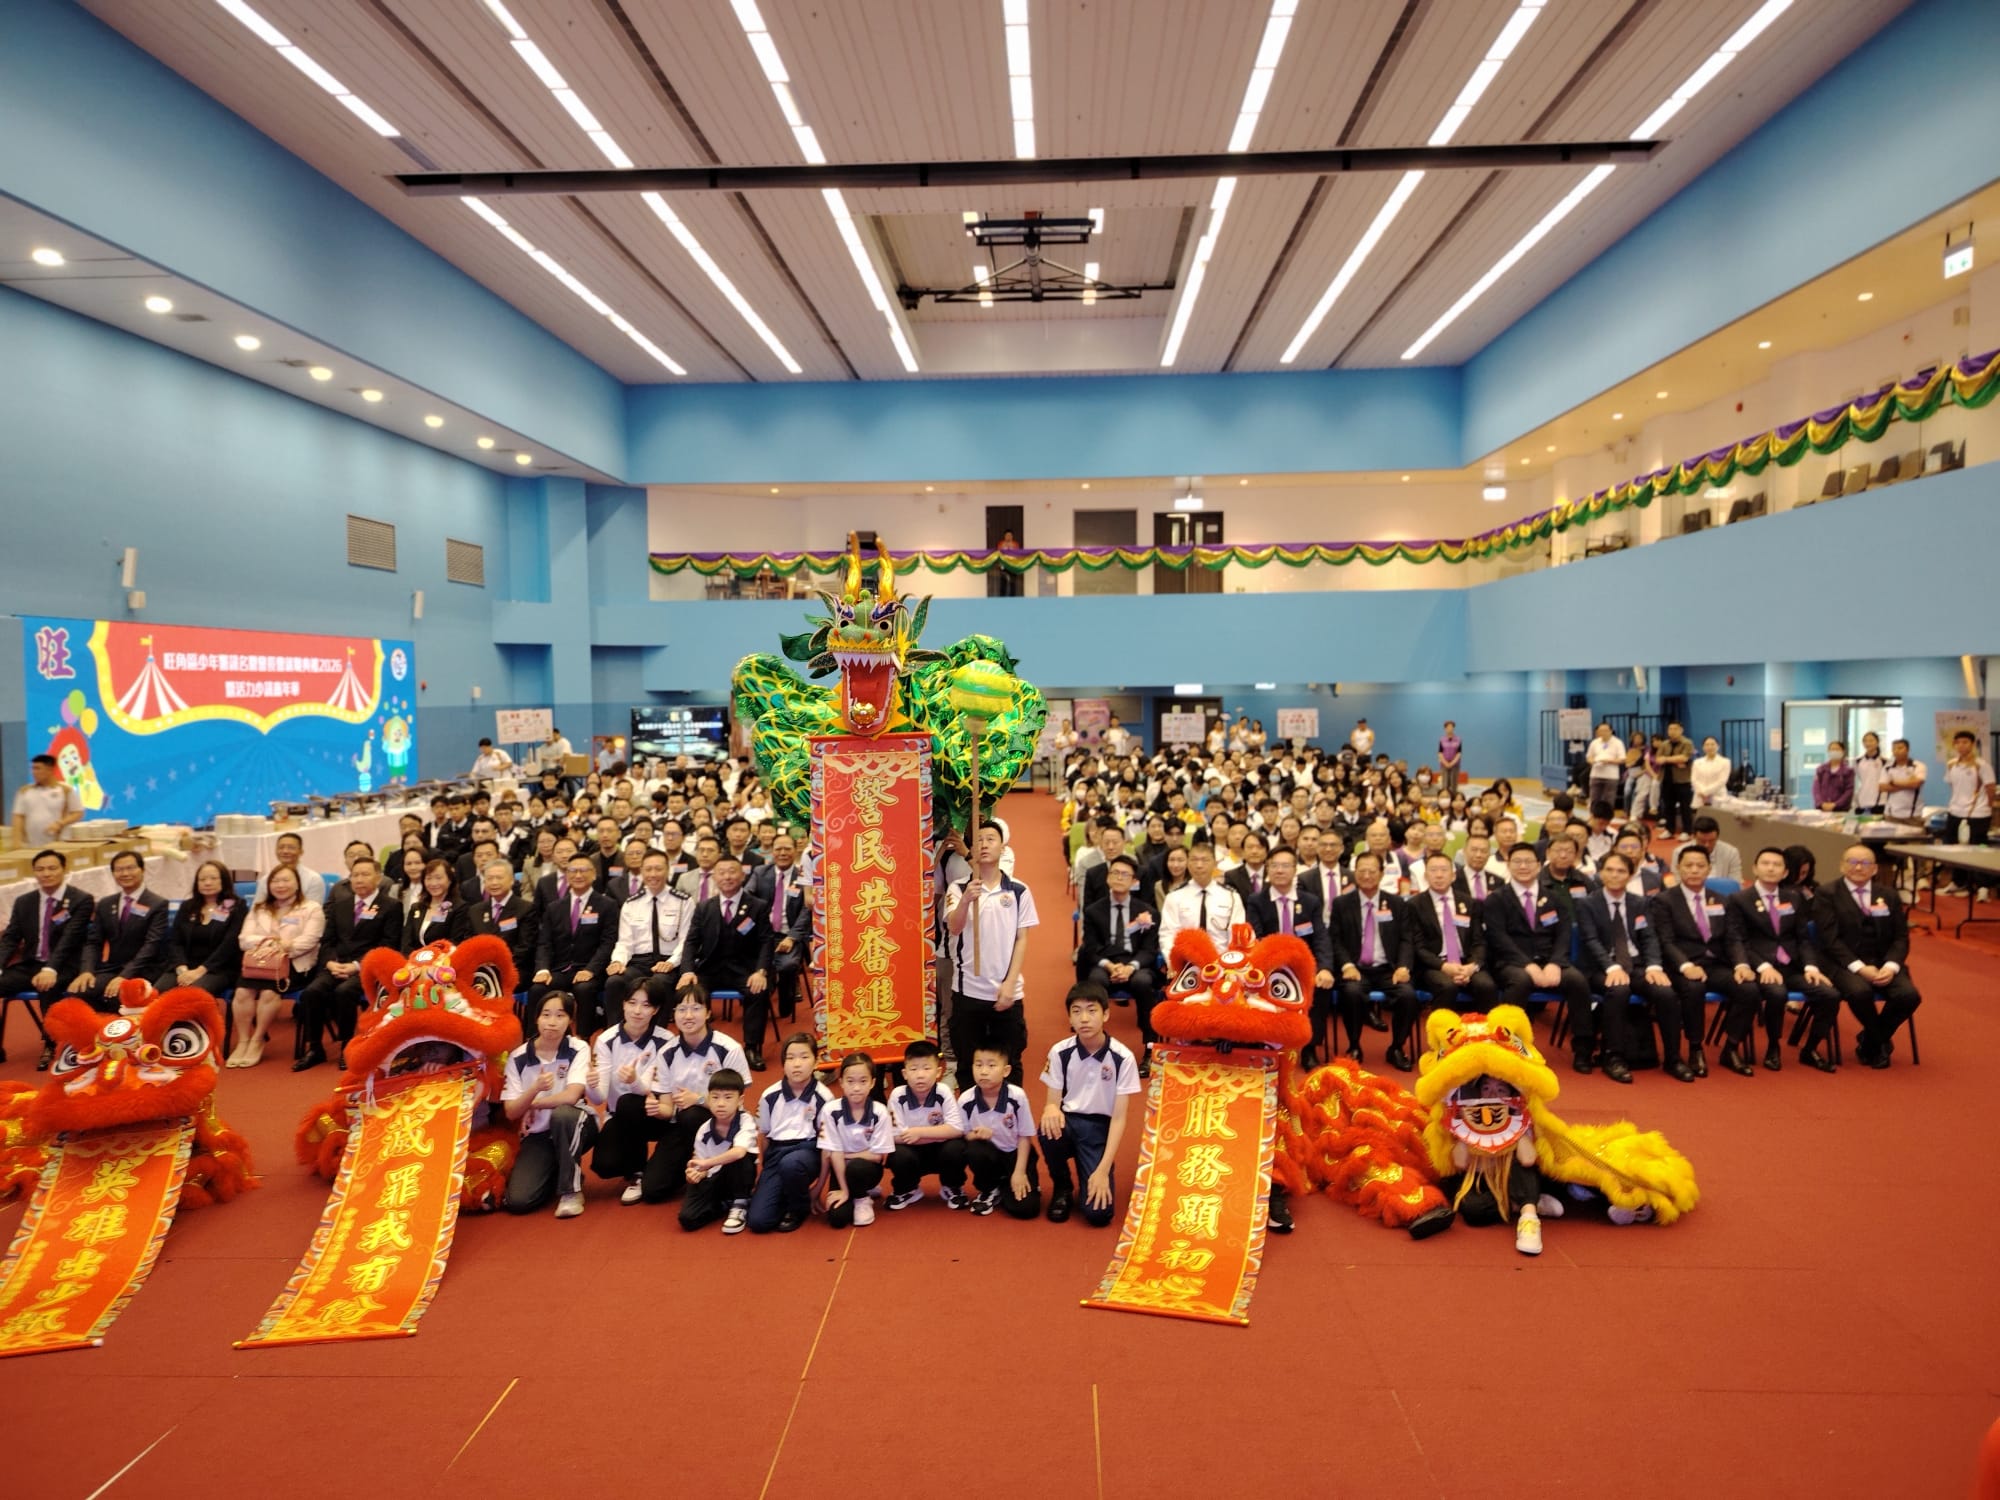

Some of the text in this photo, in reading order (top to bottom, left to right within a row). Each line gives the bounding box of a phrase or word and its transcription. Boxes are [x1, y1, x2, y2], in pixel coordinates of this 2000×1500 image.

[850, 776, 902, 1022] 警民共奮進
[319, 1113, 434, 1324] 滅罪我有份
[1148, 1094, 1238, 1296] 服務顯初心
